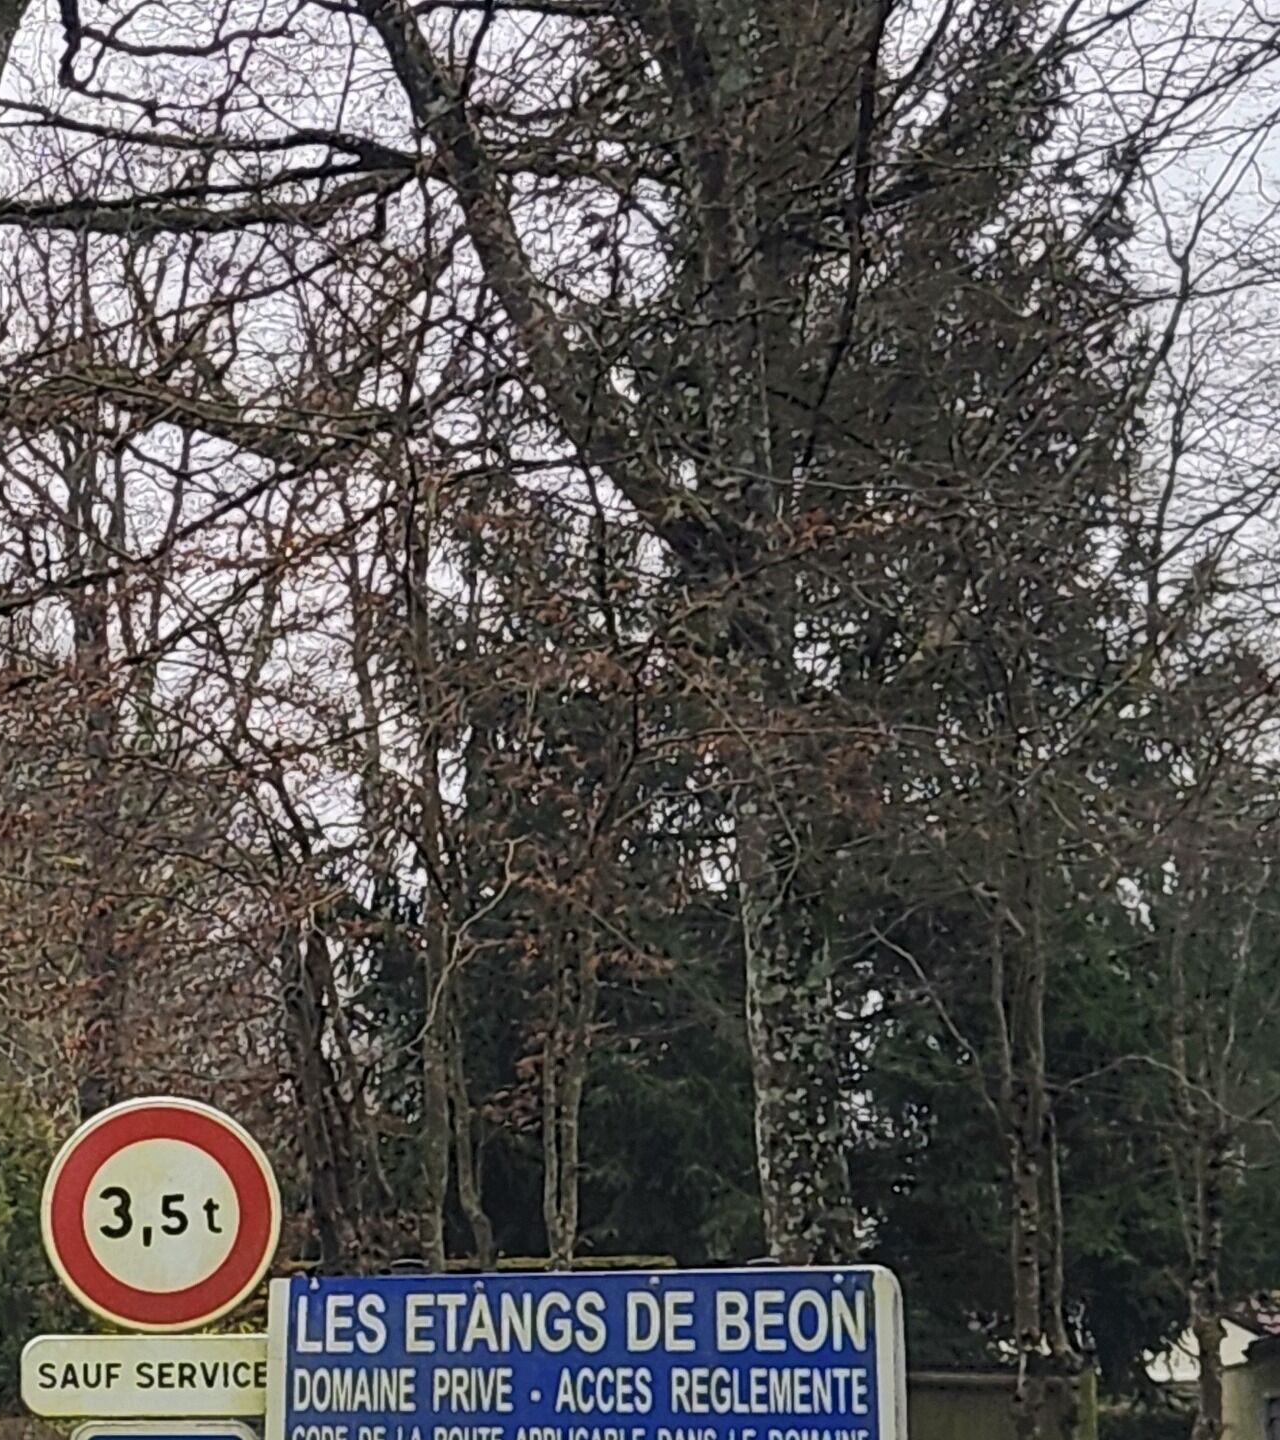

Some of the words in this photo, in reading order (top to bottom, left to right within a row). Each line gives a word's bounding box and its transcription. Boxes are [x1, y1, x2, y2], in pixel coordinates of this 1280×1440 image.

[295, 1293, 388, 1353] LES
[404, 1290, 608, 1353] ETANGS
[625, 1289, 697, 1353] DE
[715, 1288, 868, 1353] BEON
[37, 1361, 123, 1390] SAUF
[135, 1361, 268, 1389] SERVICE
[292, 1366, 418, 1413] DOMAINE
[432, 1366, 514, 1414] PRIVE
[554, 1366, 654, 1415] ACCES
[670, 1366, 869, 1415] REGLEMENTE
